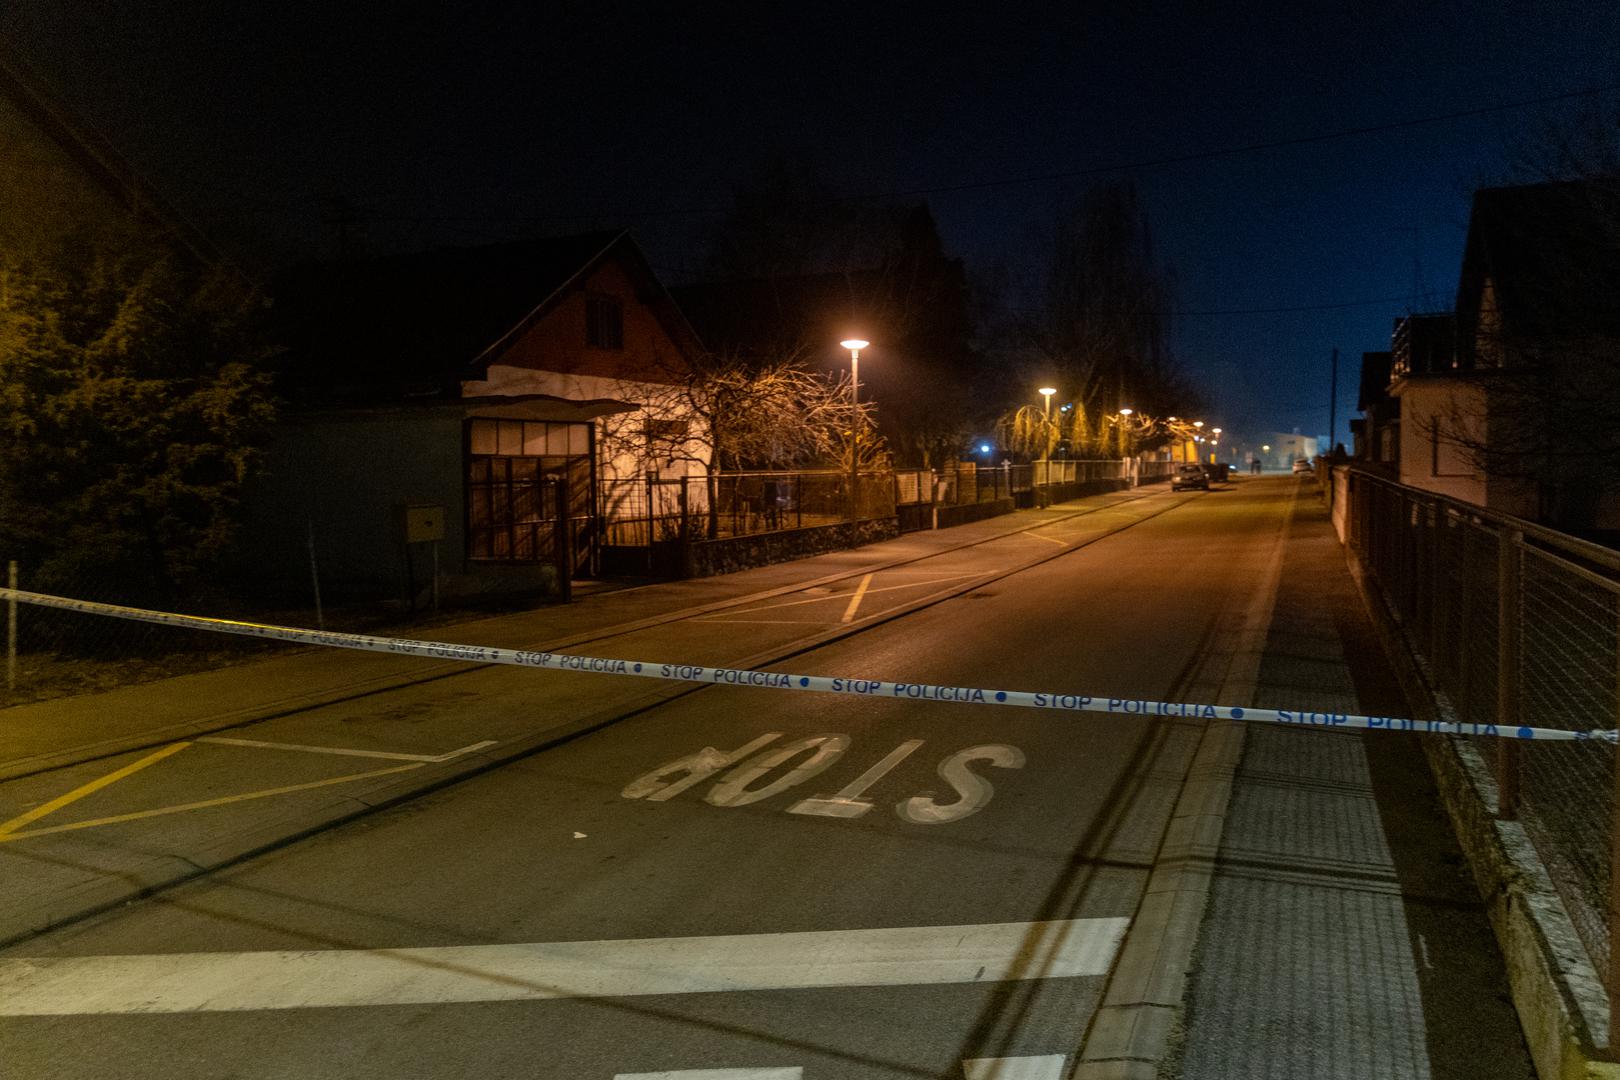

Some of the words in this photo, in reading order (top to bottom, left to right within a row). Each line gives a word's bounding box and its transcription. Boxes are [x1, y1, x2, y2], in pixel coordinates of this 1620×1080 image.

[514, 651, 551, 667] STOP
[560, 656, 627, 674] POLICIJA
[661, 664, 703, 680] STOP
[714, 669, 792, 688] POLICIJA
[832, 678, 881, 695] STOP
[894, 683, 986, 703] POLICIJA
[1034, 693, 1091, 710] STOP
[1108, 699, 1217, 719] POLICIJA
[1277, 709, 1347, 726] STOP
[621, 732, 1026, 825] STOP
